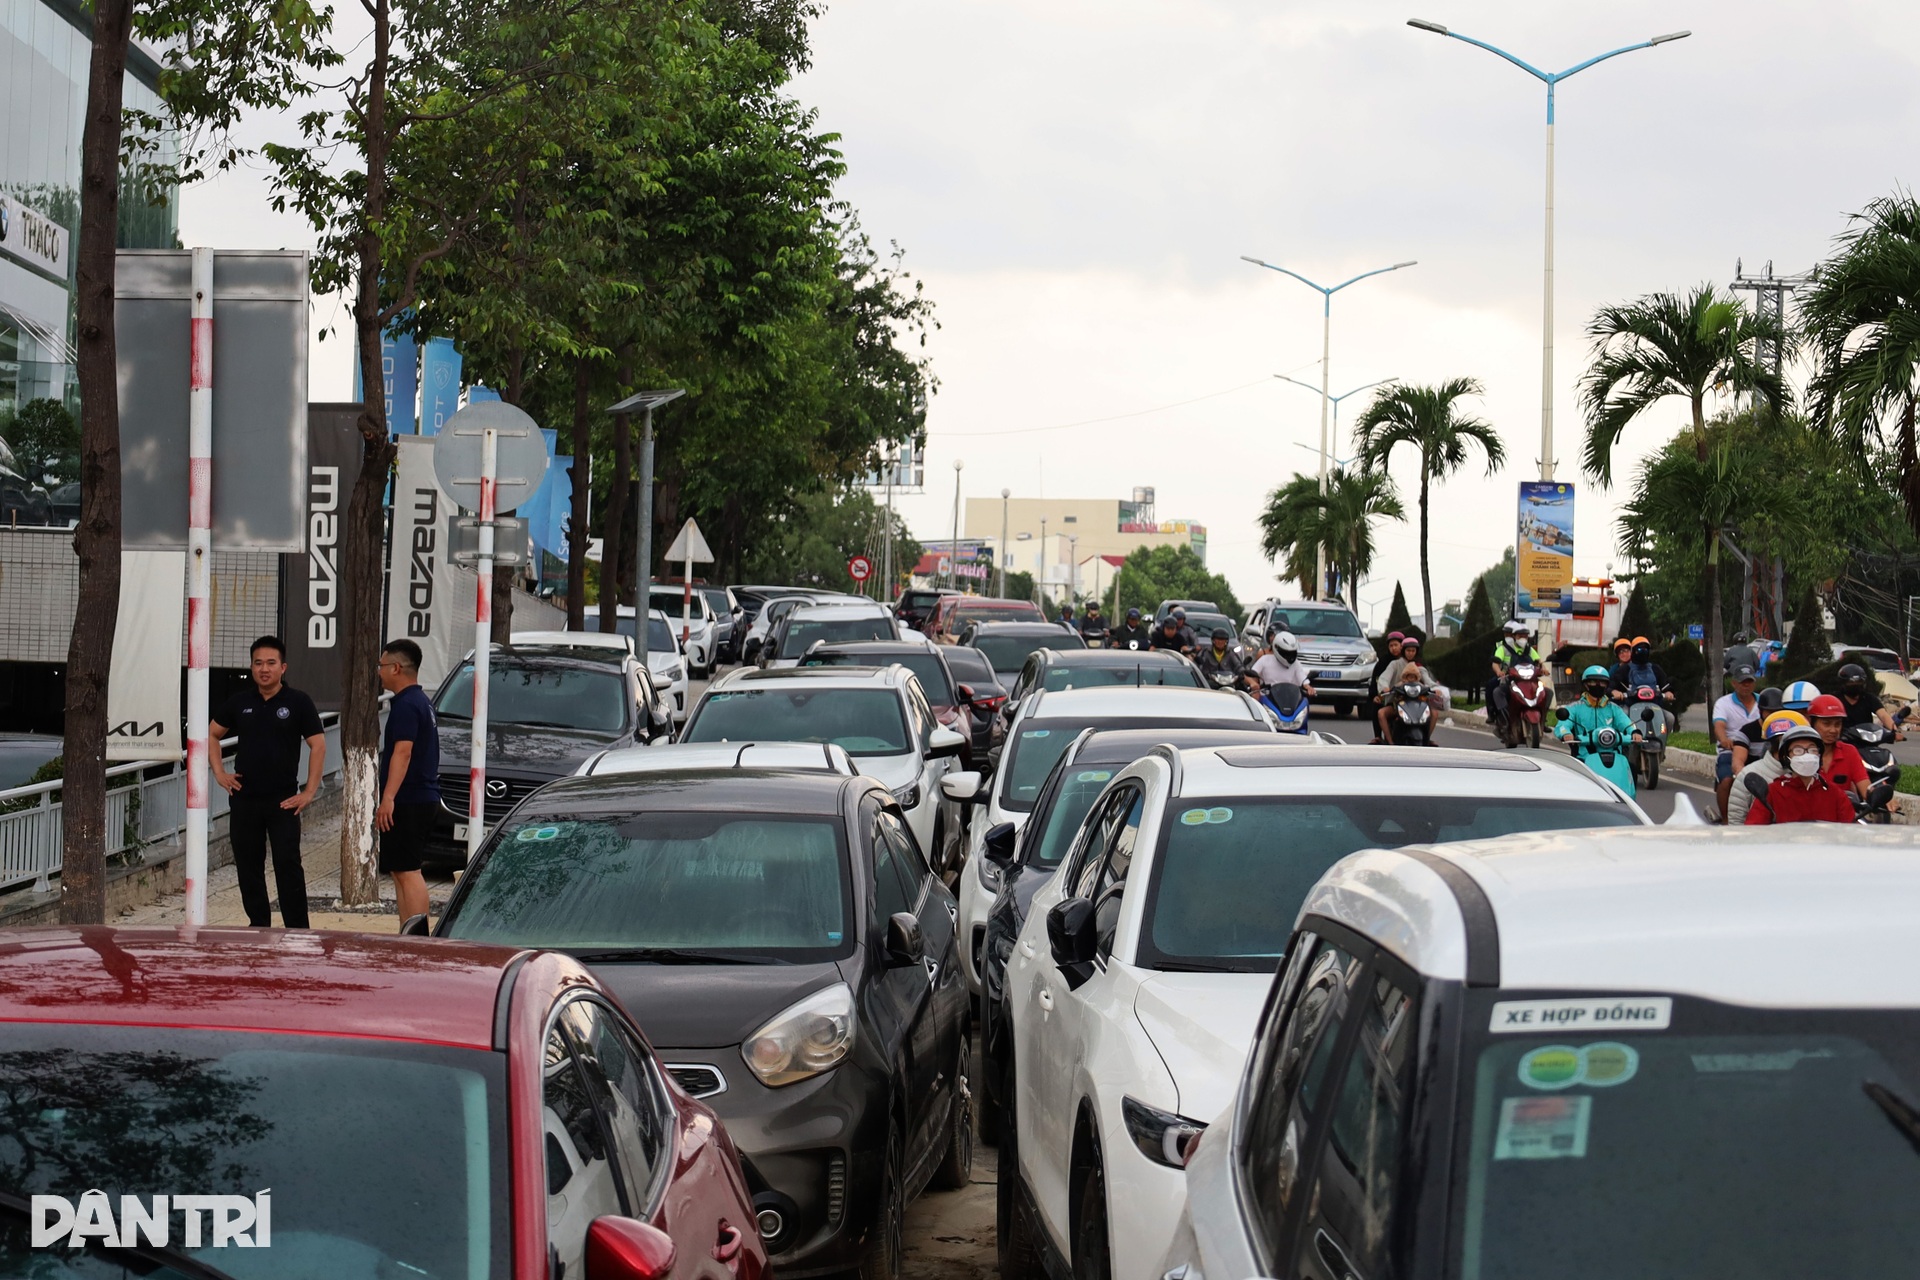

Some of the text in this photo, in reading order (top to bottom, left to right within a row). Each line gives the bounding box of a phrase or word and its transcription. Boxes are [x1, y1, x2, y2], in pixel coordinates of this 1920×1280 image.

[22, 210, 60, 264] THACO
[307, 465, 339, 649] mazda
[407, 488, 437, 637] mazda
[1505, 1009, 1533, 1023] XE
[1541, 1007, 1587, 1026] HỢP
